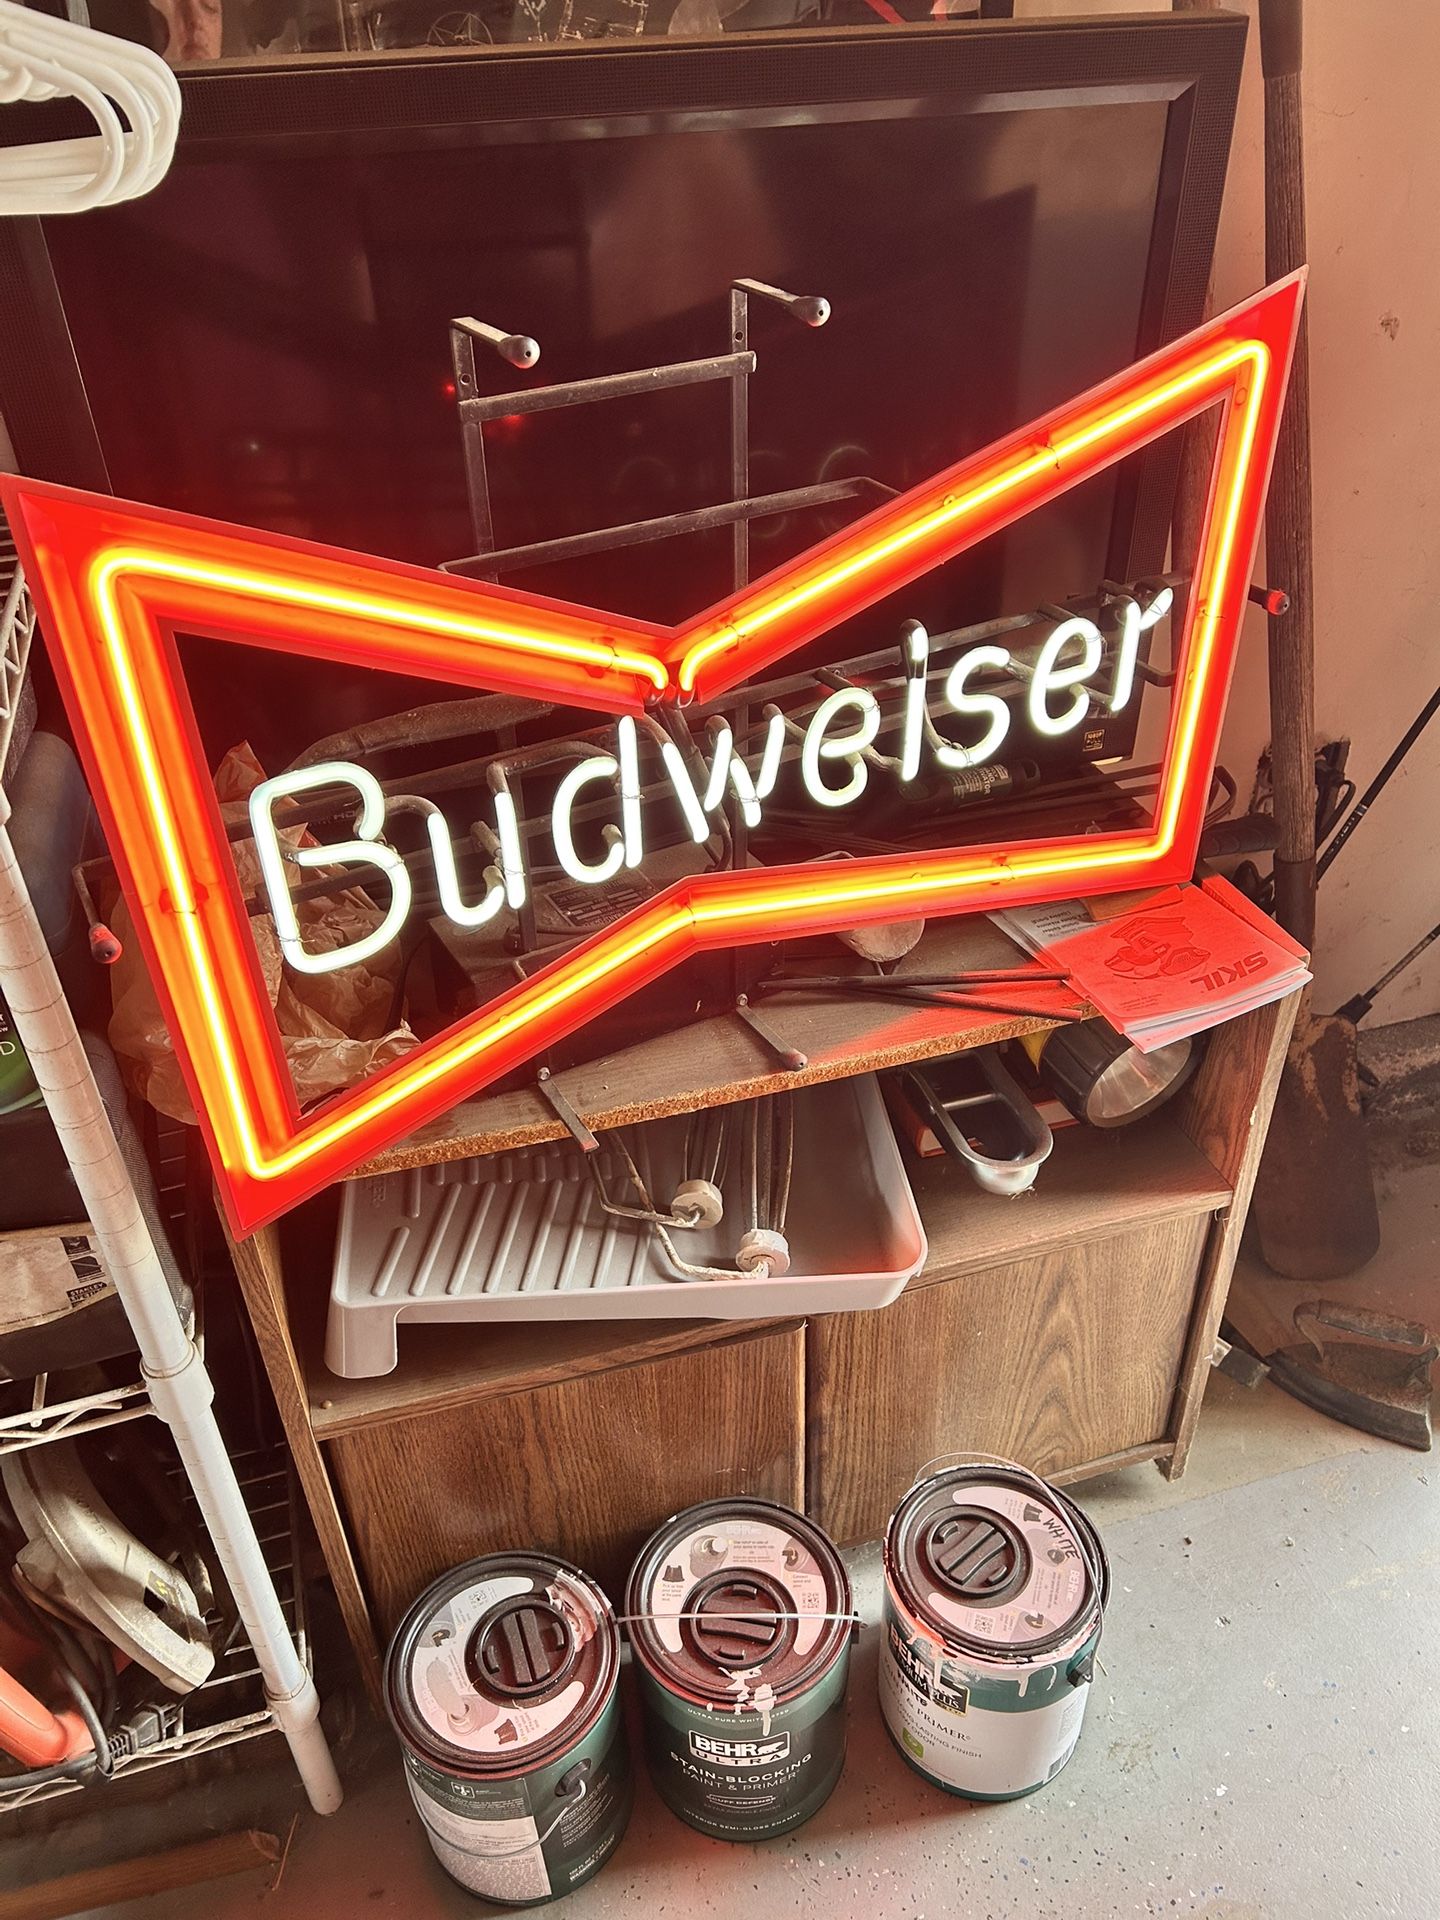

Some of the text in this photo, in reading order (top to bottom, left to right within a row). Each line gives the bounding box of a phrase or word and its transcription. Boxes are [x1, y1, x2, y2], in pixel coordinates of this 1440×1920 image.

[250, 587, 1173, 974] Budweiser
[1190, 951, 1269, 991] SKIL
[1043, 1518, 1081, 1560] WHITE
[694, 1734, 758, 1757] BEHR
[695, 1751, 782, 1765] ULTRA
[670, 1751, 812, 1784] STAIN-BLOCKING
[682, 1768, 722, 1789] PAINT
